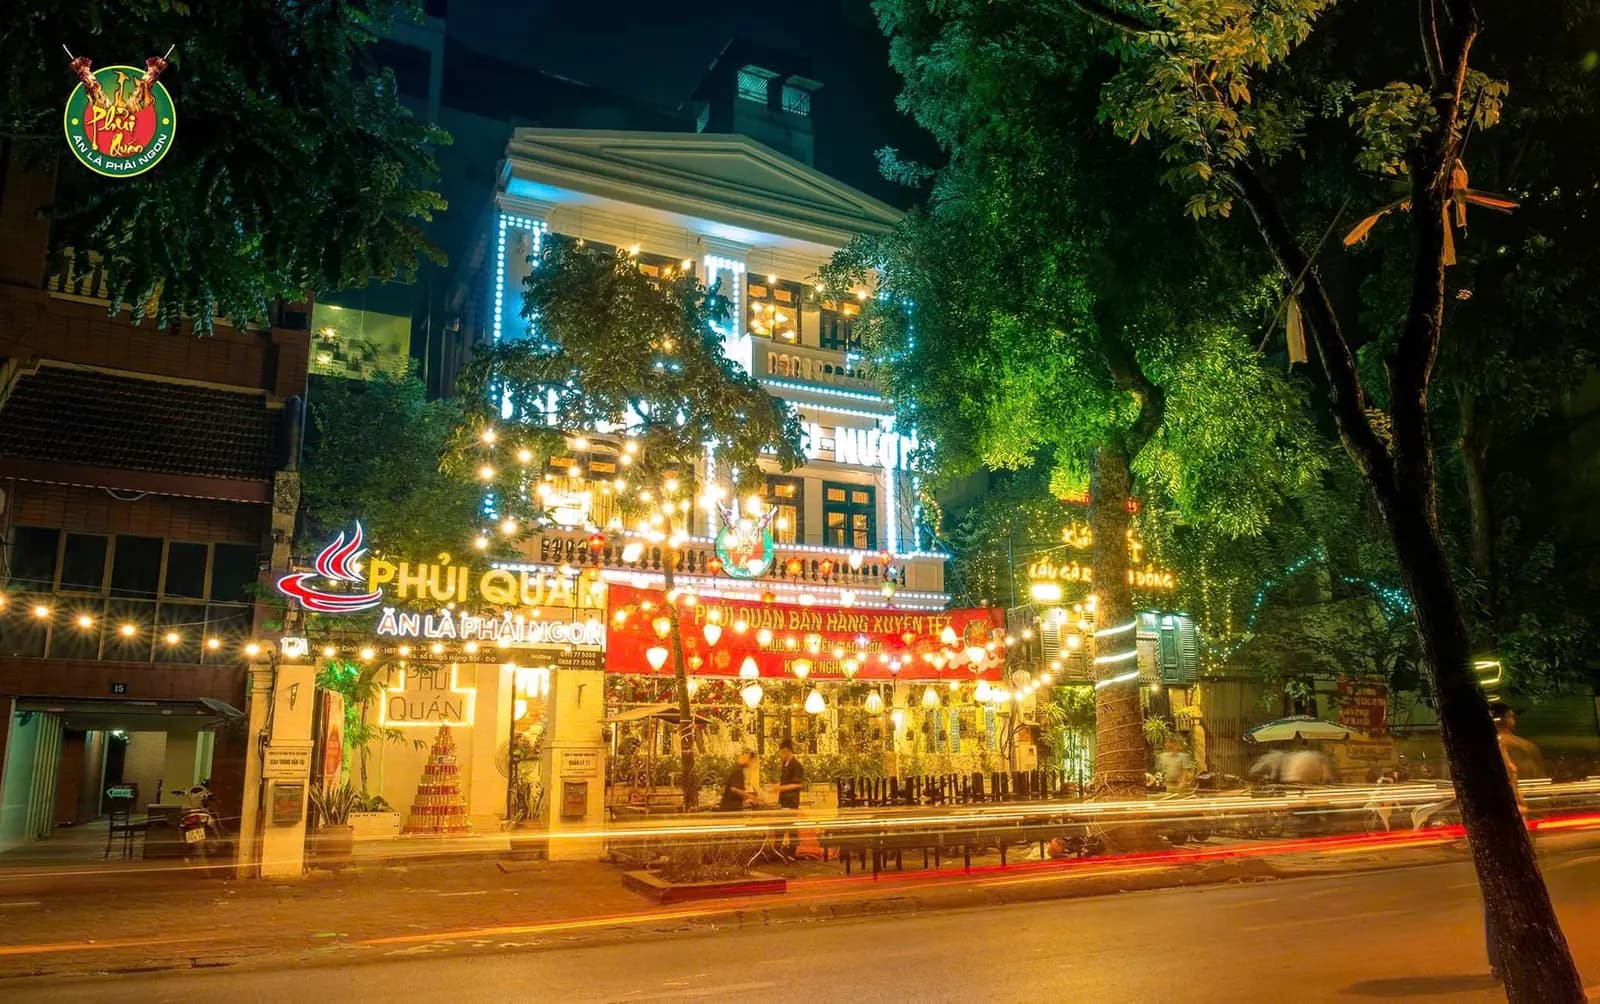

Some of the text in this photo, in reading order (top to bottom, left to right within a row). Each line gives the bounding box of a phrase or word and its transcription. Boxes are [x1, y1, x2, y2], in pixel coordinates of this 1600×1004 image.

[369, 552, 468, 602] PHỦI
[377, 607, 604, 645] ĂN LÀ PHẢI NGON
[788, 607, 823, 631] BÁN
[826, 611, 869, 633] HÀNG
[389, 695, 463, 721] QUÁN
